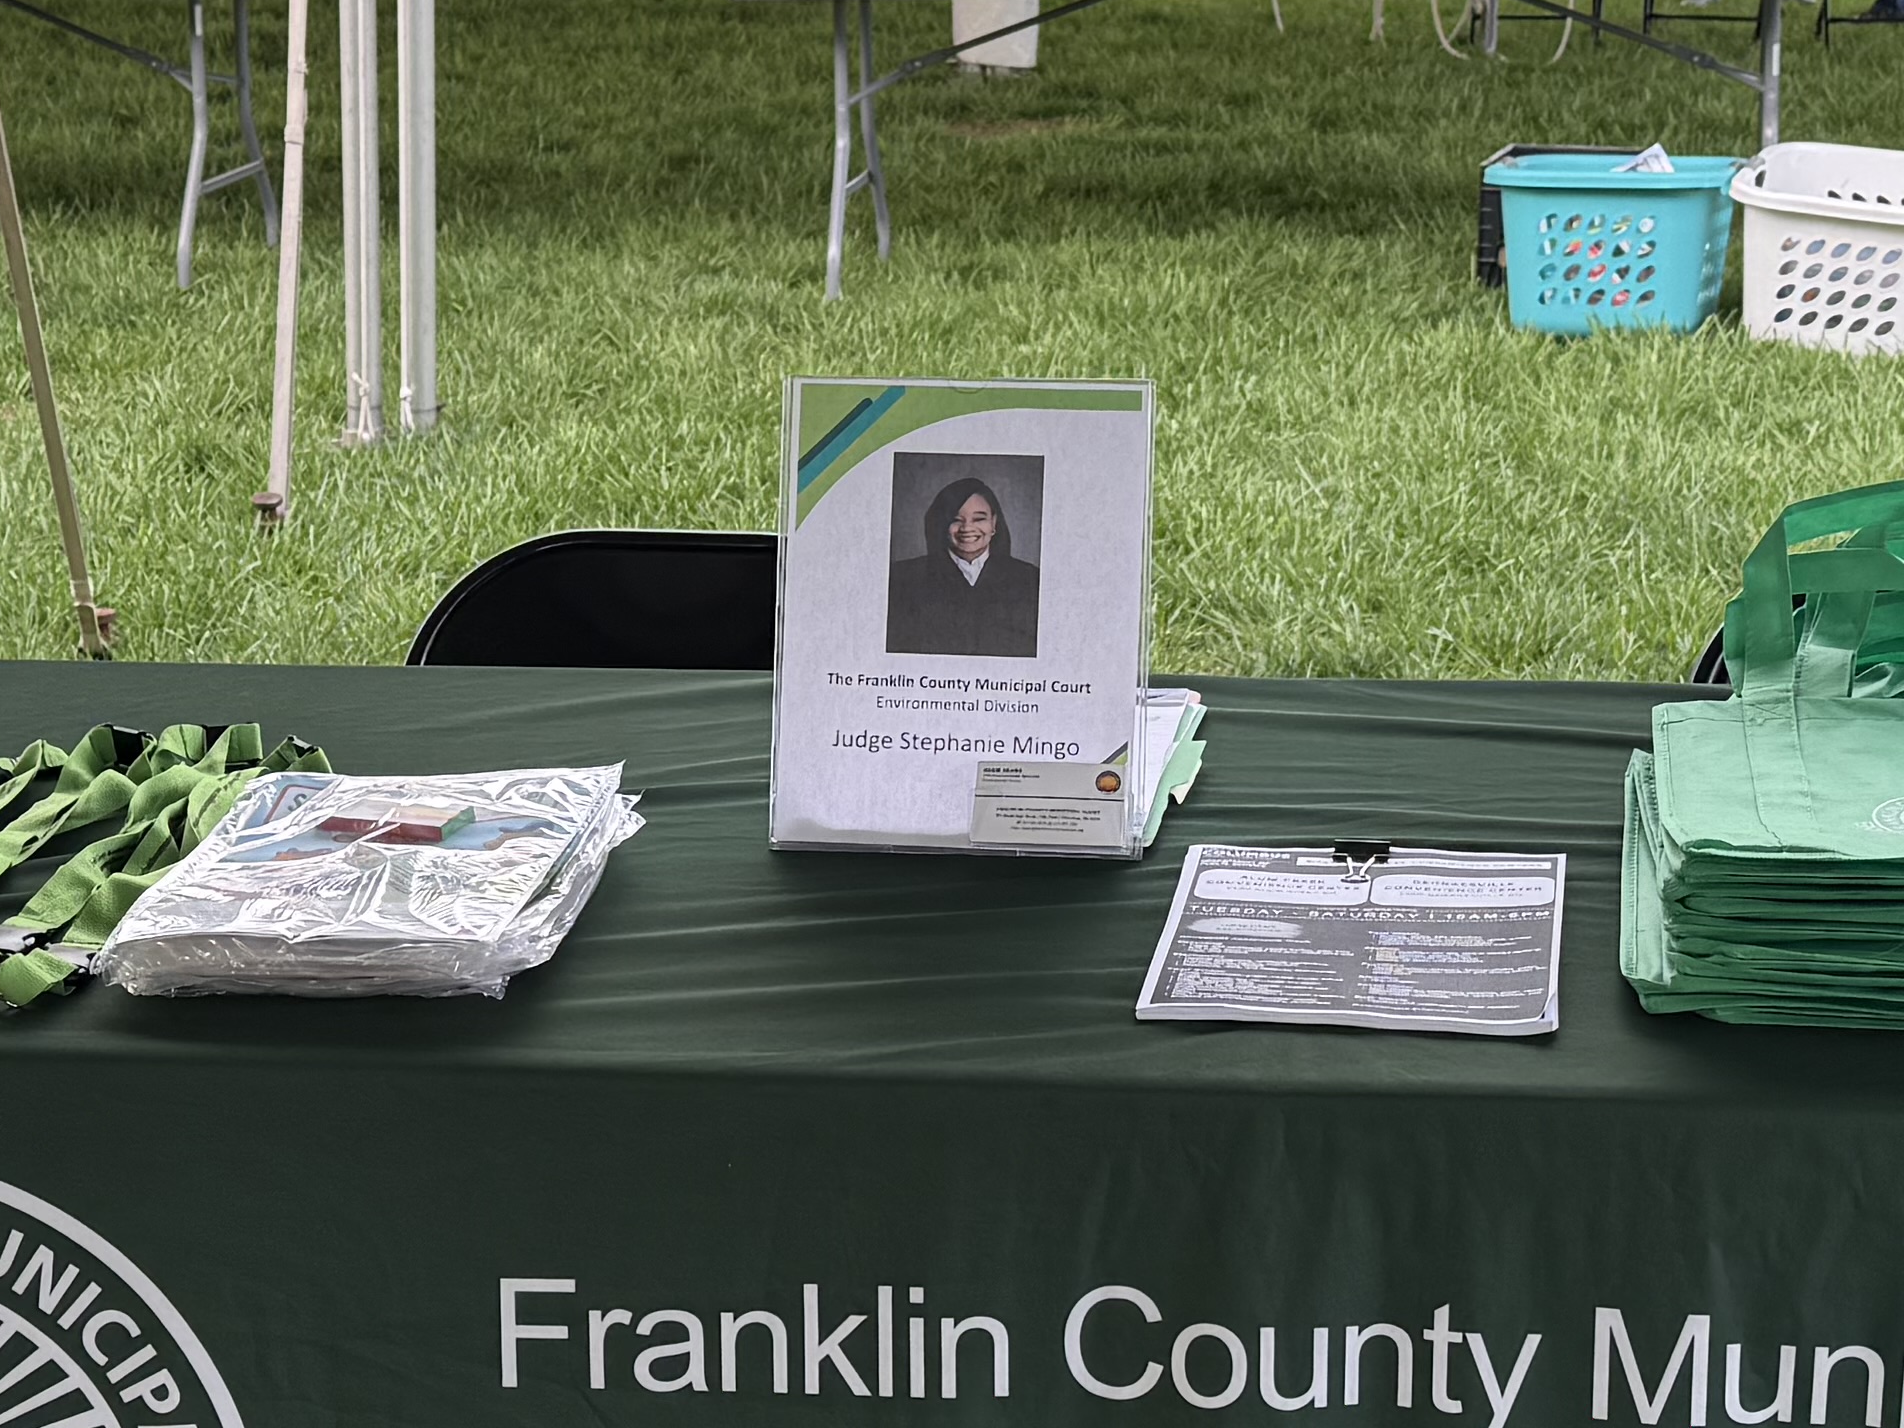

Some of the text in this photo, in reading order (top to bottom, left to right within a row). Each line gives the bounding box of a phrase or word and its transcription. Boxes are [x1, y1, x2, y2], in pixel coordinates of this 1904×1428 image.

[828, 673, 1091, 694] The Franklin County Municipal Court
[877, 696, 1039, 713] Environmental Division
[833, 730, 1079, 759] Judge Stephanie Mingo
[1190, 905, 1283, 916] TUESDAY
[1309, 910, 1419, 920] SATURDAY
[499, 1278, 1010, 1400] Franklin
